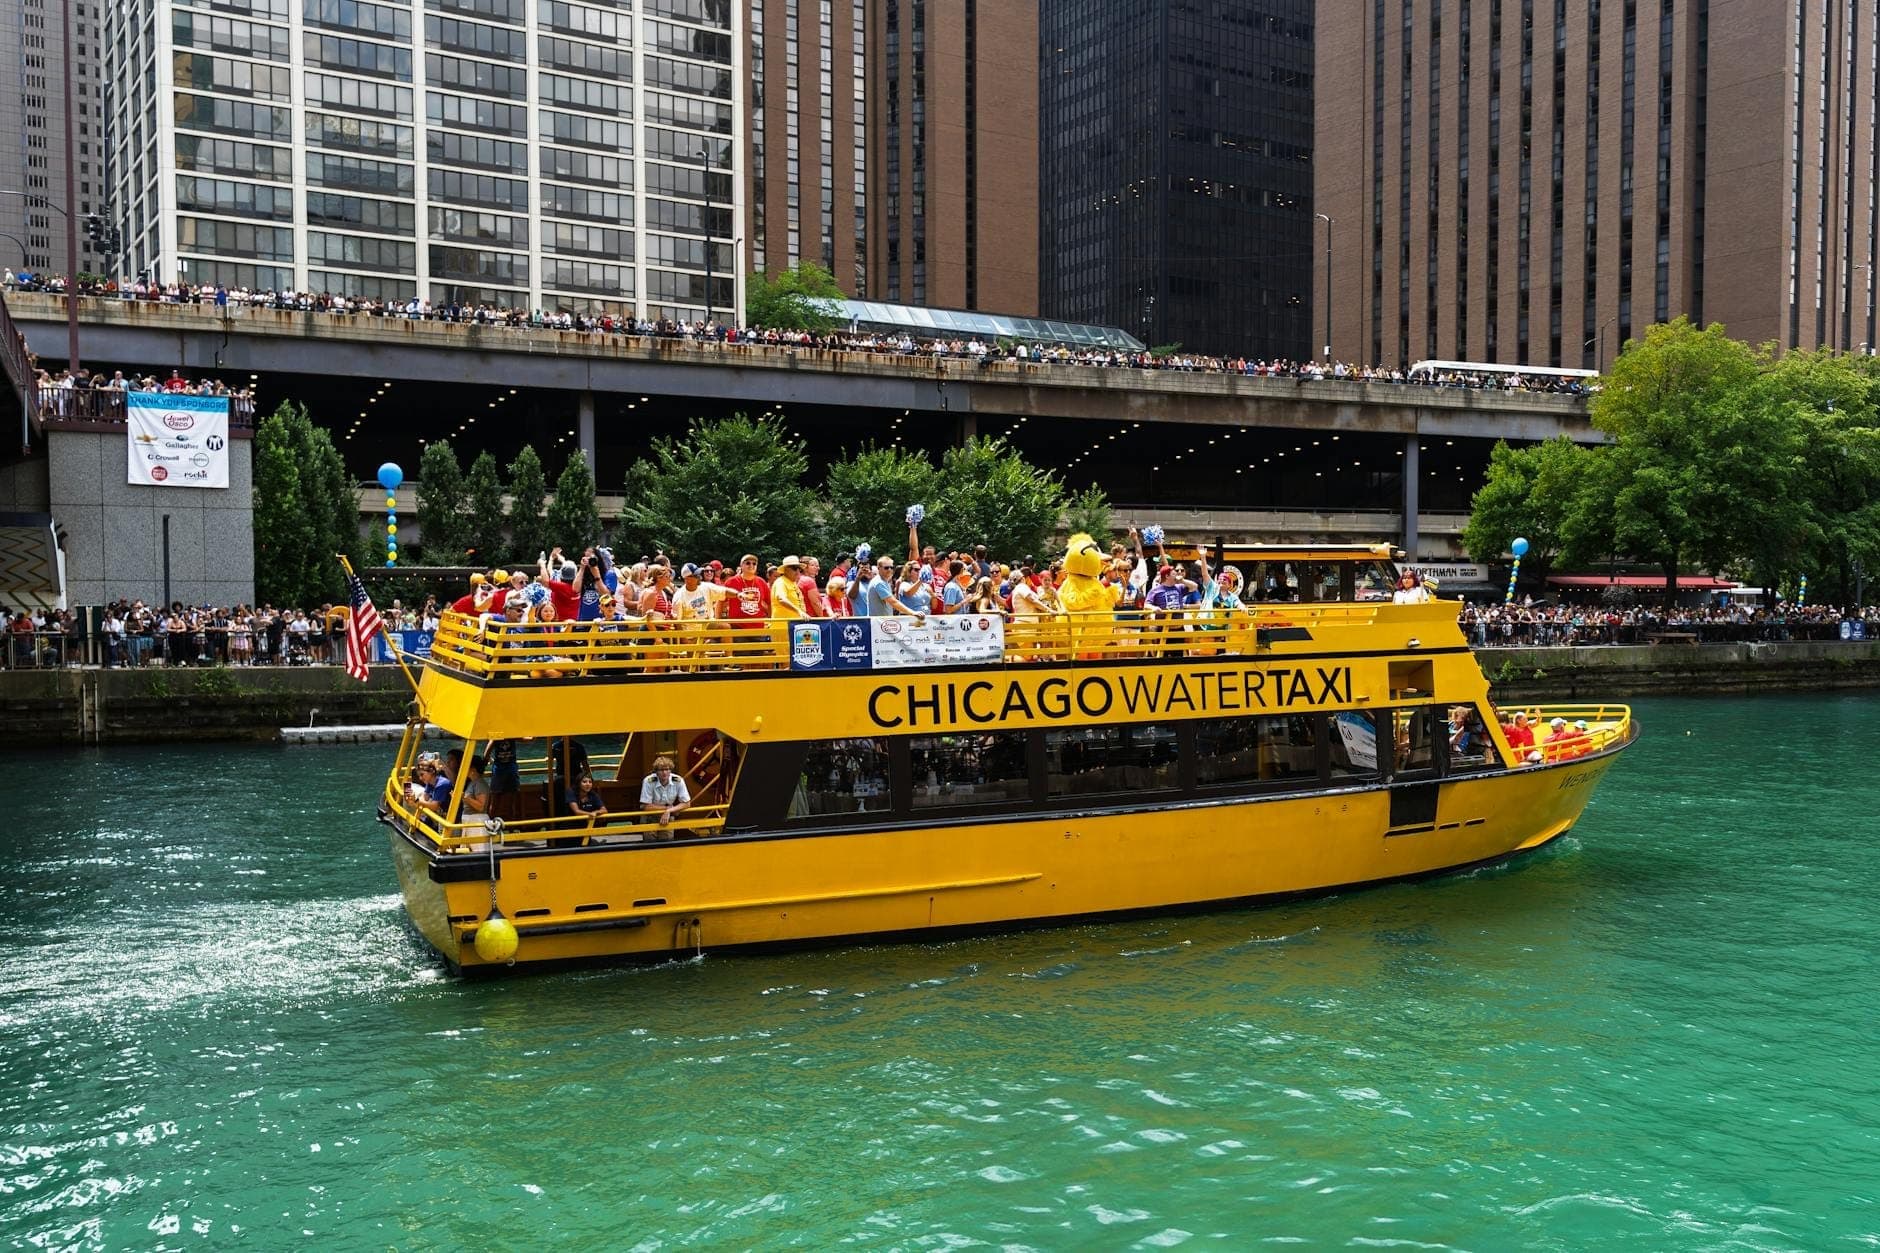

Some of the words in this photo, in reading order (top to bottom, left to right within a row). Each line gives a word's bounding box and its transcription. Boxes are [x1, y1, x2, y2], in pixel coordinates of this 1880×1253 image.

[130, 396, 160, 405] THANK
[161, 398, 179, 406] YOU
[181, 400, 226, 409] SPONSORS
